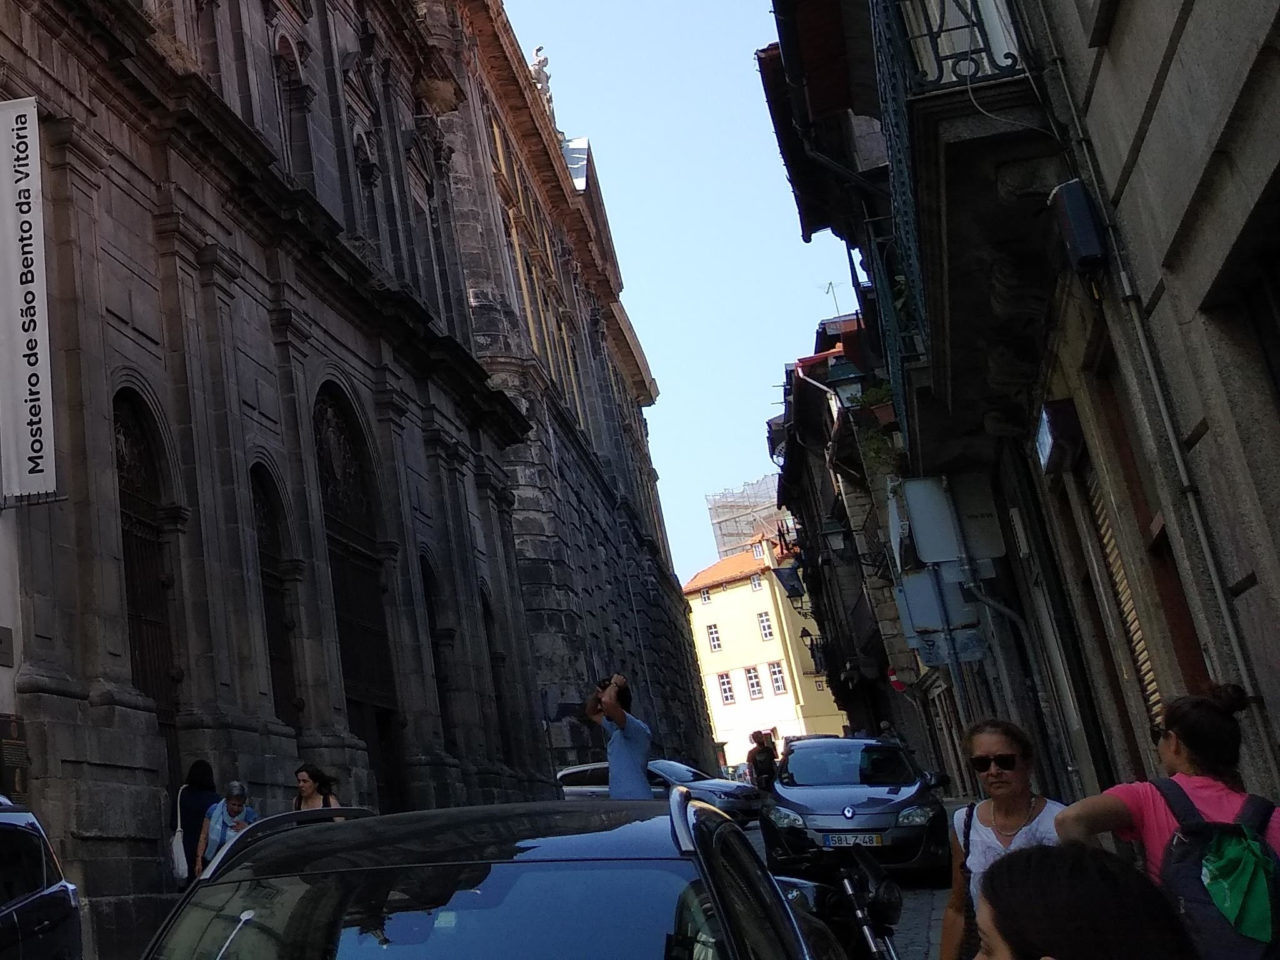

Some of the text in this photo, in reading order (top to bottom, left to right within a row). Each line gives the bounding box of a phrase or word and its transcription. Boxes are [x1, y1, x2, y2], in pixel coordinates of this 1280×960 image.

[11, 113, 45, 475] Mosteiro de São Bento da Vitória
